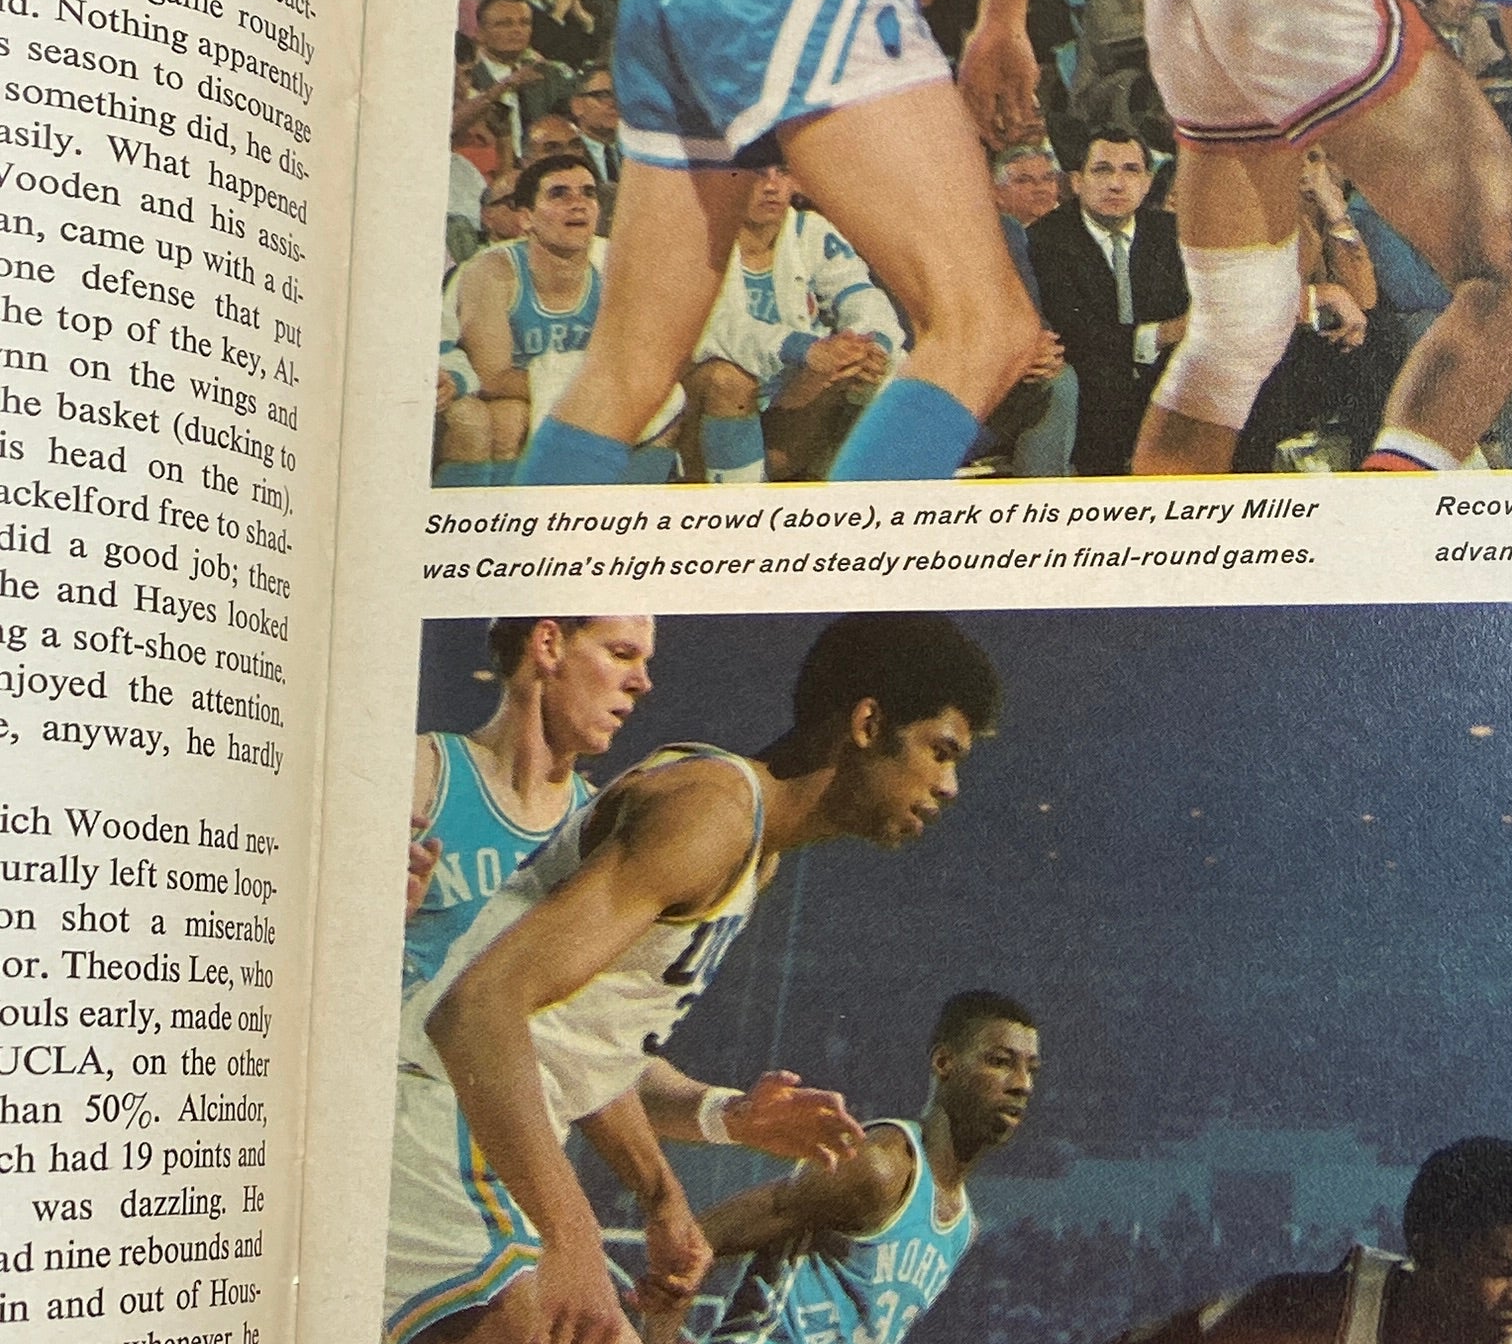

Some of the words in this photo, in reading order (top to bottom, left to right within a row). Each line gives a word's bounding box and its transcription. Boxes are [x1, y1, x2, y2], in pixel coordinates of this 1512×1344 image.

[198, 38, 313, 106] apparently
[5, 82, 177, 137] something
[187, 114, 236, 155] did,
[246, 131, 272, 164] he
[279, 148, 309, 180] dis-
[107, 135, 190, 179] What
[208, 160, 307, 225] happened
[82, 264, 195, 309] defense
[215, 294, 260, 329] that
[274, 319, 301, 348] put
[57, 392, 160, 434] basket
[173, 412, 275, 469] (ducking
[281, 446, 295, 471] to
[158, 498, 209, 533] free
[217, 512, 240, 539] to
[246, 519, 292, 554] shad-
[425, 513, 539, 537] Shooting
[547, 511, 648, 535] through
[657, 516, 671, 530] a
[680, 509, 764, 530] crowd
[770, 505, 881, 532] (above),
[890, 511, 905, 526] a
[913, 505, 982, 525] mark
[989, 504, 1019, 524] of
[1022, 503, 1060, 523] his
[1066, 506, 1156, 526] power,
[1165, 501, 1234, 524] Larry
[1241, 498, 1319, 519] Miller
[424, 563, 471, 579] was
[609, 556, 665, 580] high
[670, 559, 755, 575] scorer
[759, 553, 810, 573] and
[812, 551, 900, 576] steady
[903, 549, 1042, 571] rebounder
[1044, 548, 1067, 568] in
[1073, 545, 1221, 567] final-round
[1222, 549, 1314, 569] games.
[57, 580, 118, 608] and
[134, 584, 217, 623] Hayes
[228, 600, 288, 641] looked
[41, 628, 61, 648] a
[74, 626, 206, 666] soft-shoe
[215, 650, 285, 684] routine.
[43, 721, 169, 757] anyway,
[187, 726, 215, 757] he
[227, 733, 283, 775] hardly
[64, 808, 190, 845] Wooden
[198, 819, 239, 850] had
[245, 834, 279, 855] nev-
[61, 950, 180, 983] Theodis
[188, 955, 234, 991] Lee,
[240, 960, 273, 988] who
[85, 1092, 160, 1130] 50%.
[177, 1093, 267, 1128] Alcindor,
[32, 1199, 92, 1221] was
[120, 1186, 226, 1220] dazzling.
[242, 1185, 264, 1213] He
[44, 1239, 111, 1271] nine
[118, 1232, 229, 1267] rebounds
[234, 1230, 262, 1259] and
[872, 1237, 951, 1308] NORT
